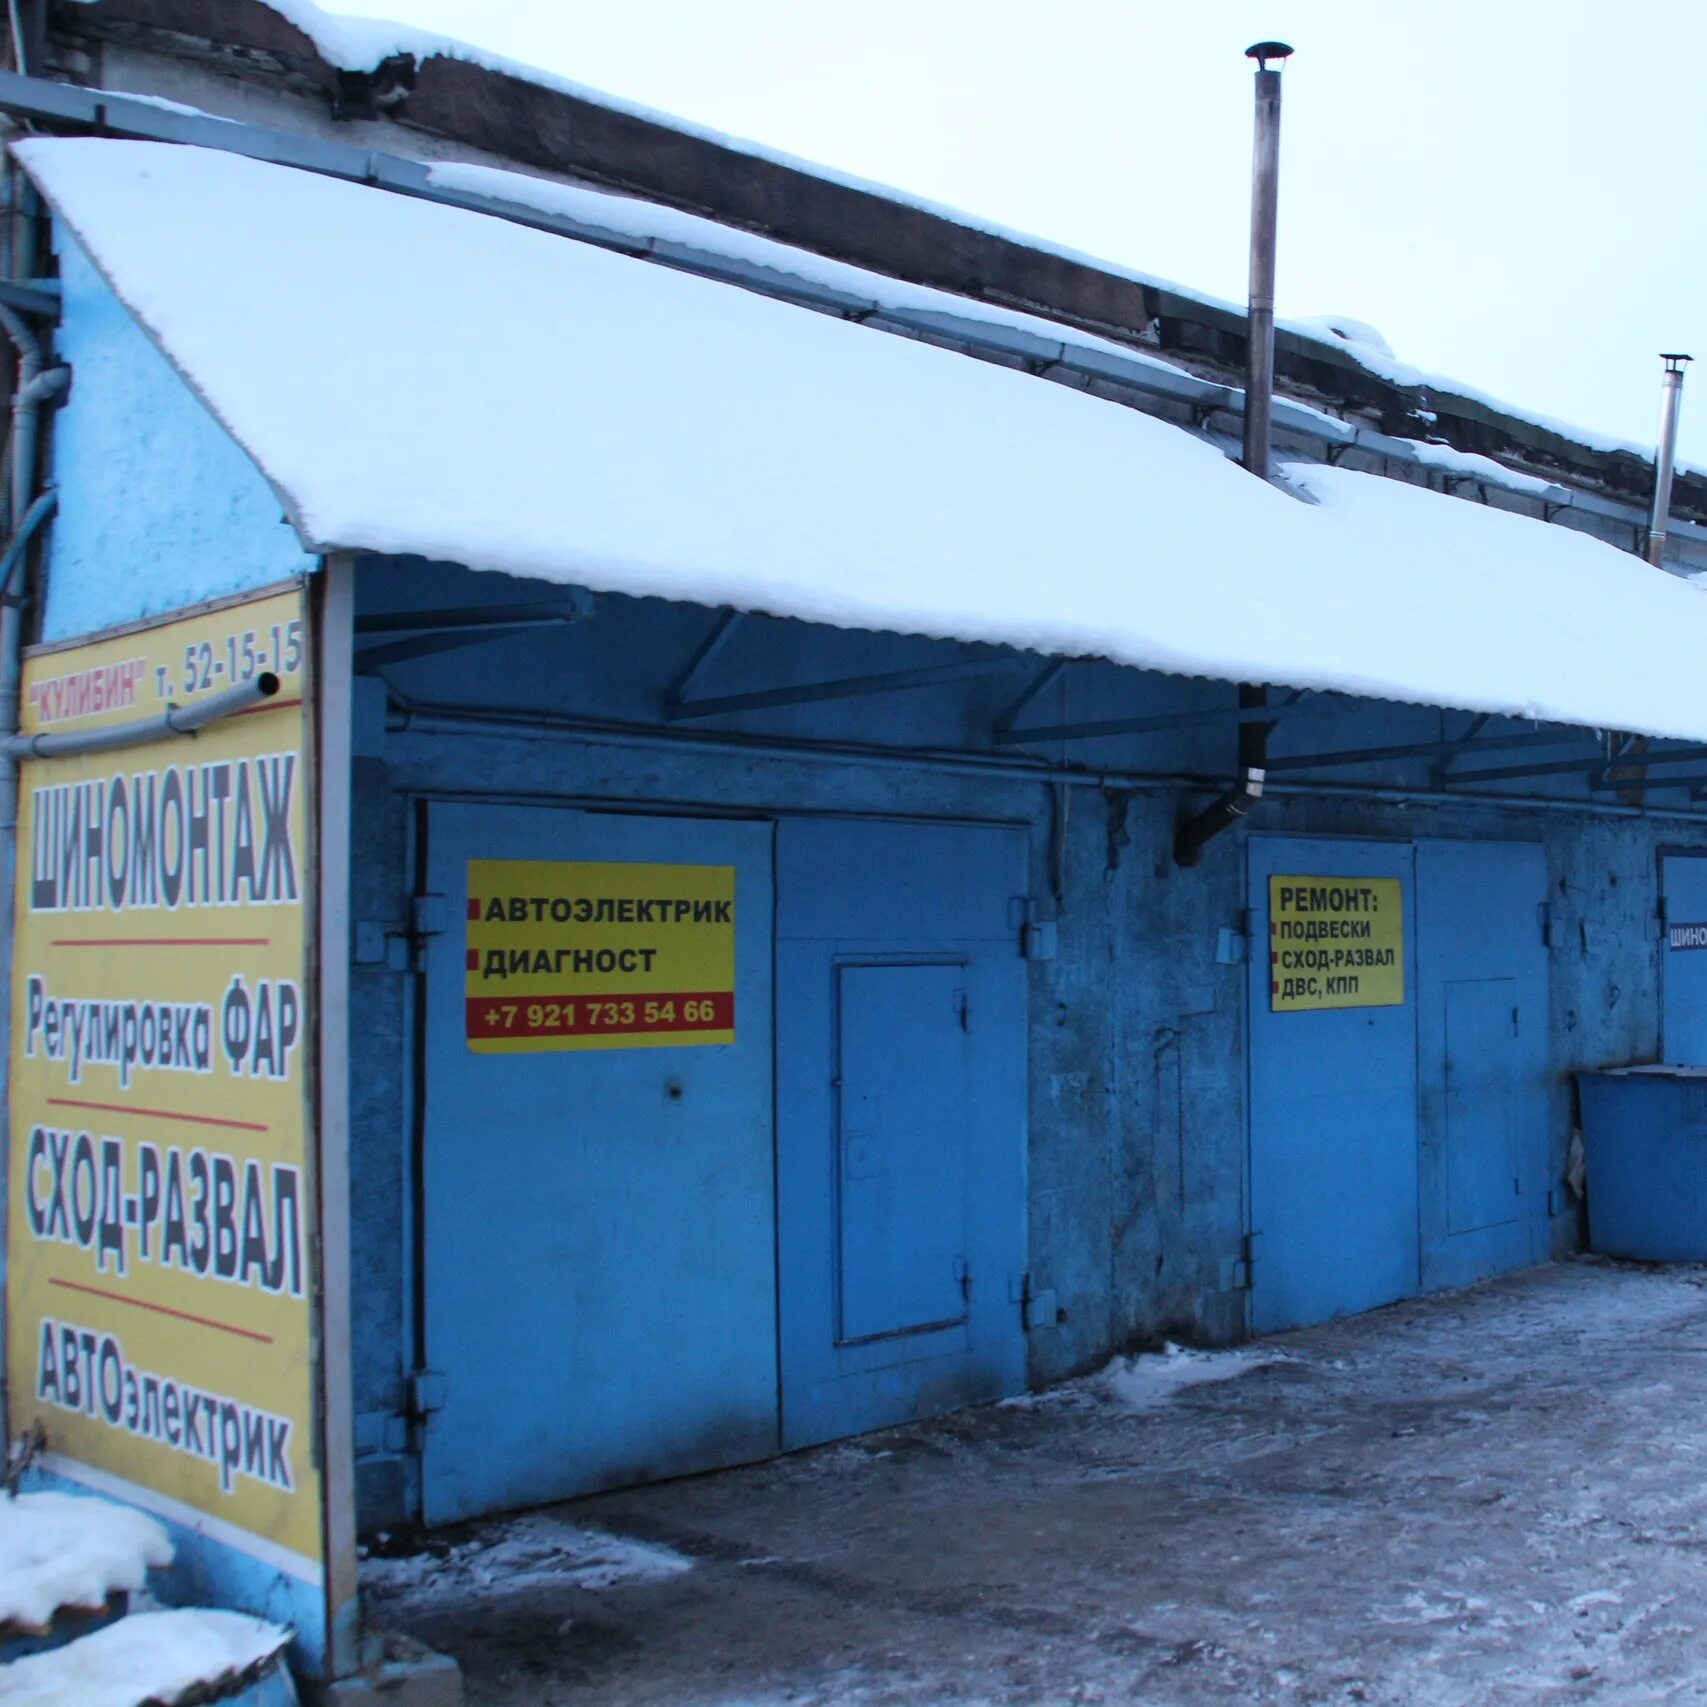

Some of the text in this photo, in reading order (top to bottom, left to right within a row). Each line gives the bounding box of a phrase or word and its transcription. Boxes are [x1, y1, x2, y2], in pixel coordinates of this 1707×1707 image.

[184, 620, 301, 693] 52-15-15
[31, 751, 300, 913] ШИНОМОНТАЖ
[485, 897, 731, 923] АВТОЭЛЕКТРИК
[1280, 887, 1378, 912] РЕМОНТ:
[1280, 920, 1371, 942] ПОДВЕСКИ
[483, 948, 657, 979] ДИАГНОСТ
[1282, 949, 1394, 971] СХОД-РАЗВАЛ
[1282, 976, 1359, 1000] ДВС, КПП
[484, 1000, 715, 1028] +7 921 733 54 66
[25, 974, 300, 1090] Регулировка ФАР
[26, 1124, 304, 1299] СХОД-РАЗВАЛ
[37, 1317, 295, 1494] АВТОэлектрик
